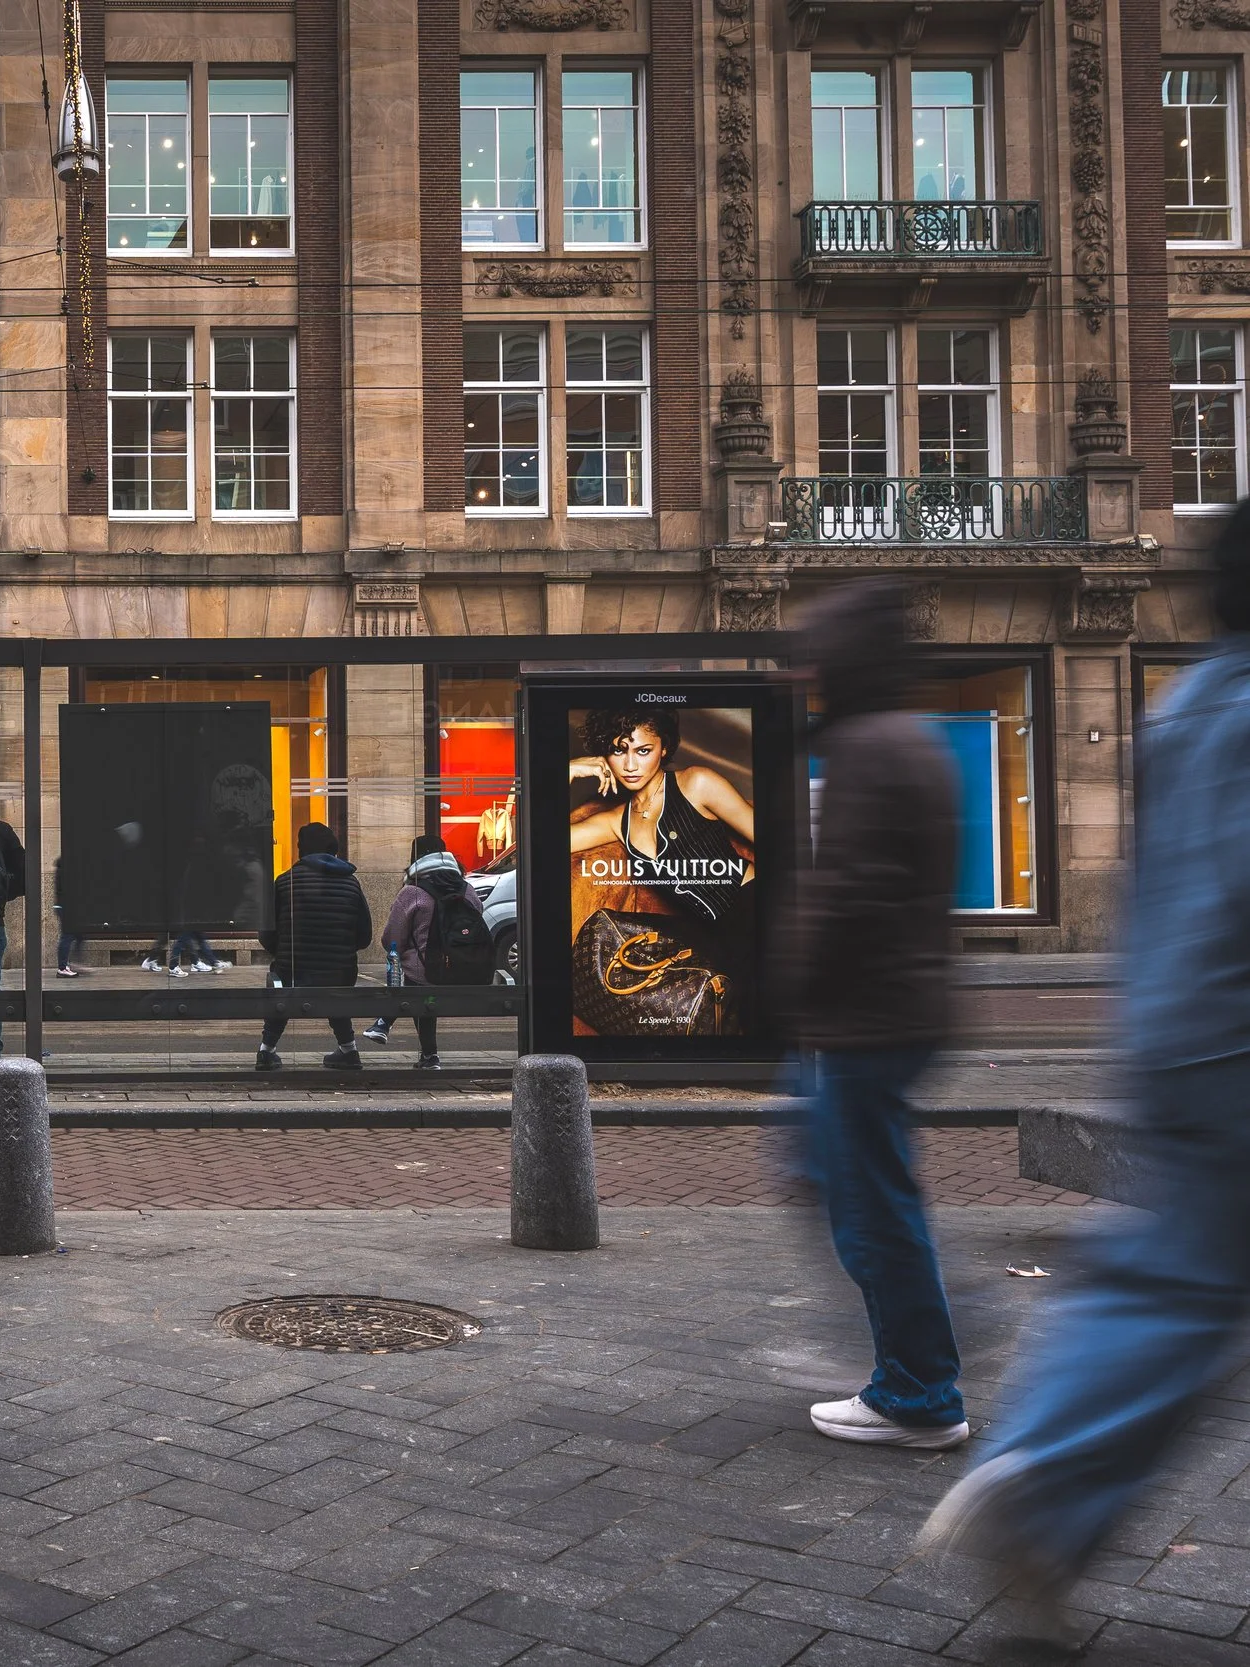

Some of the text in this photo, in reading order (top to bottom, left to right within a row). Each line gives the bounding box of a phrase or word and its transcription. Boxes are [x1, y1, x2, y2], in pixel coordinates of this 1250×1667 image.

[634, 693, 687, 703] JCDecaux
[581, 859, 743, 877] LOUIS VUITTON
[638, 1016, 648, 1024] Le
[648, 1016, 671, 1025] Speedy
[676, 1016, 691, 1024] 1930
